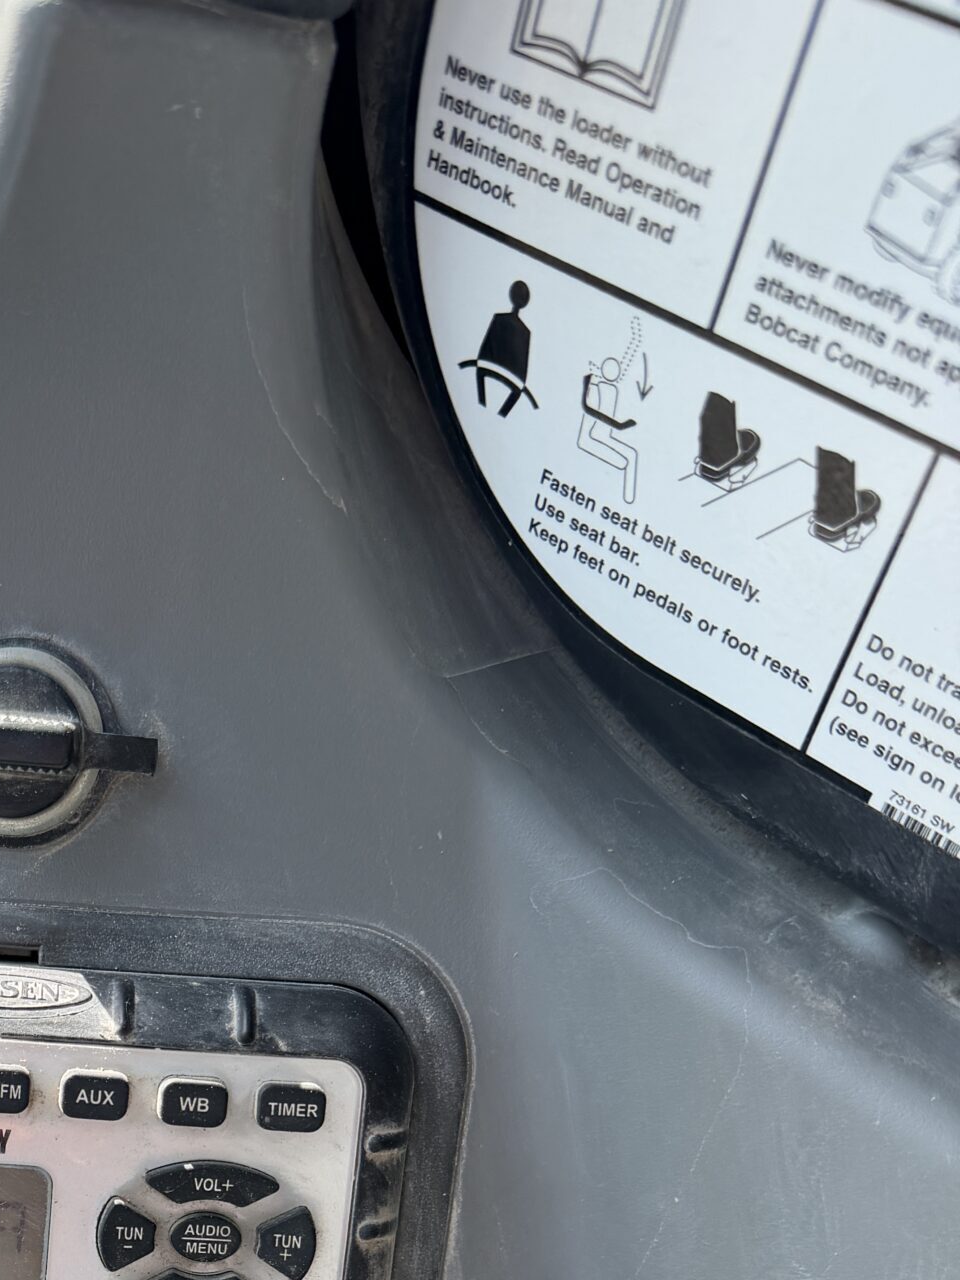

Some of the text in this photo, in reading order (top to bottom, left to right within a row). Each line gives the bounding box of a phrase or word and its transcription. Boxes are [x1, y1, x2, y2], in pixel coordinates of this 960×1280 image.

[445, 54, 713, 188] Never use the loader without
[427, 150, 517, 208] Handbook.
[438, 89, 702, 221] instructions. Read Operation
[433, 120, 675, 245] & Maintenance Manual and
[766, 238, 830, 281] Never
[834, 274, 912, 324] modify
[755, 276, 887, 348] attachments
[892, 338, 931, 369] not
[744, 303, 930, 407] Bobcat Company.
[534, 493, 641, 566] Use seat bar.
[540, 468, 761, 603] Fasten seat belt securely.
[528, 518, 814, 693] Keep feet on pedals or foot rests.
[853, 662, 905, 706] Load,
[866, 634, 895, 661] Do
[898, 655, 934, 683] not
[841, 688, 868, 715] Do
[872, 708, 906, 737] not
[828, 715, 869, 748] (see
[873, 743, 915, 776] sign
[919, 770, 946, 793] on
[889, 790, 956, 835] 73161 SW
[75, 1090, 115, 1106] AUX
[179, 1096, 210, 1113] WB
[268, 1102, 318, 1118] TIMER
[115, 1226, 143, 1241] TUN
[184, 1224, 231, 1239] AUDIO
[185, 1241, 228, 1256] MENU
[274, 1233, 302, 1249] TUN
